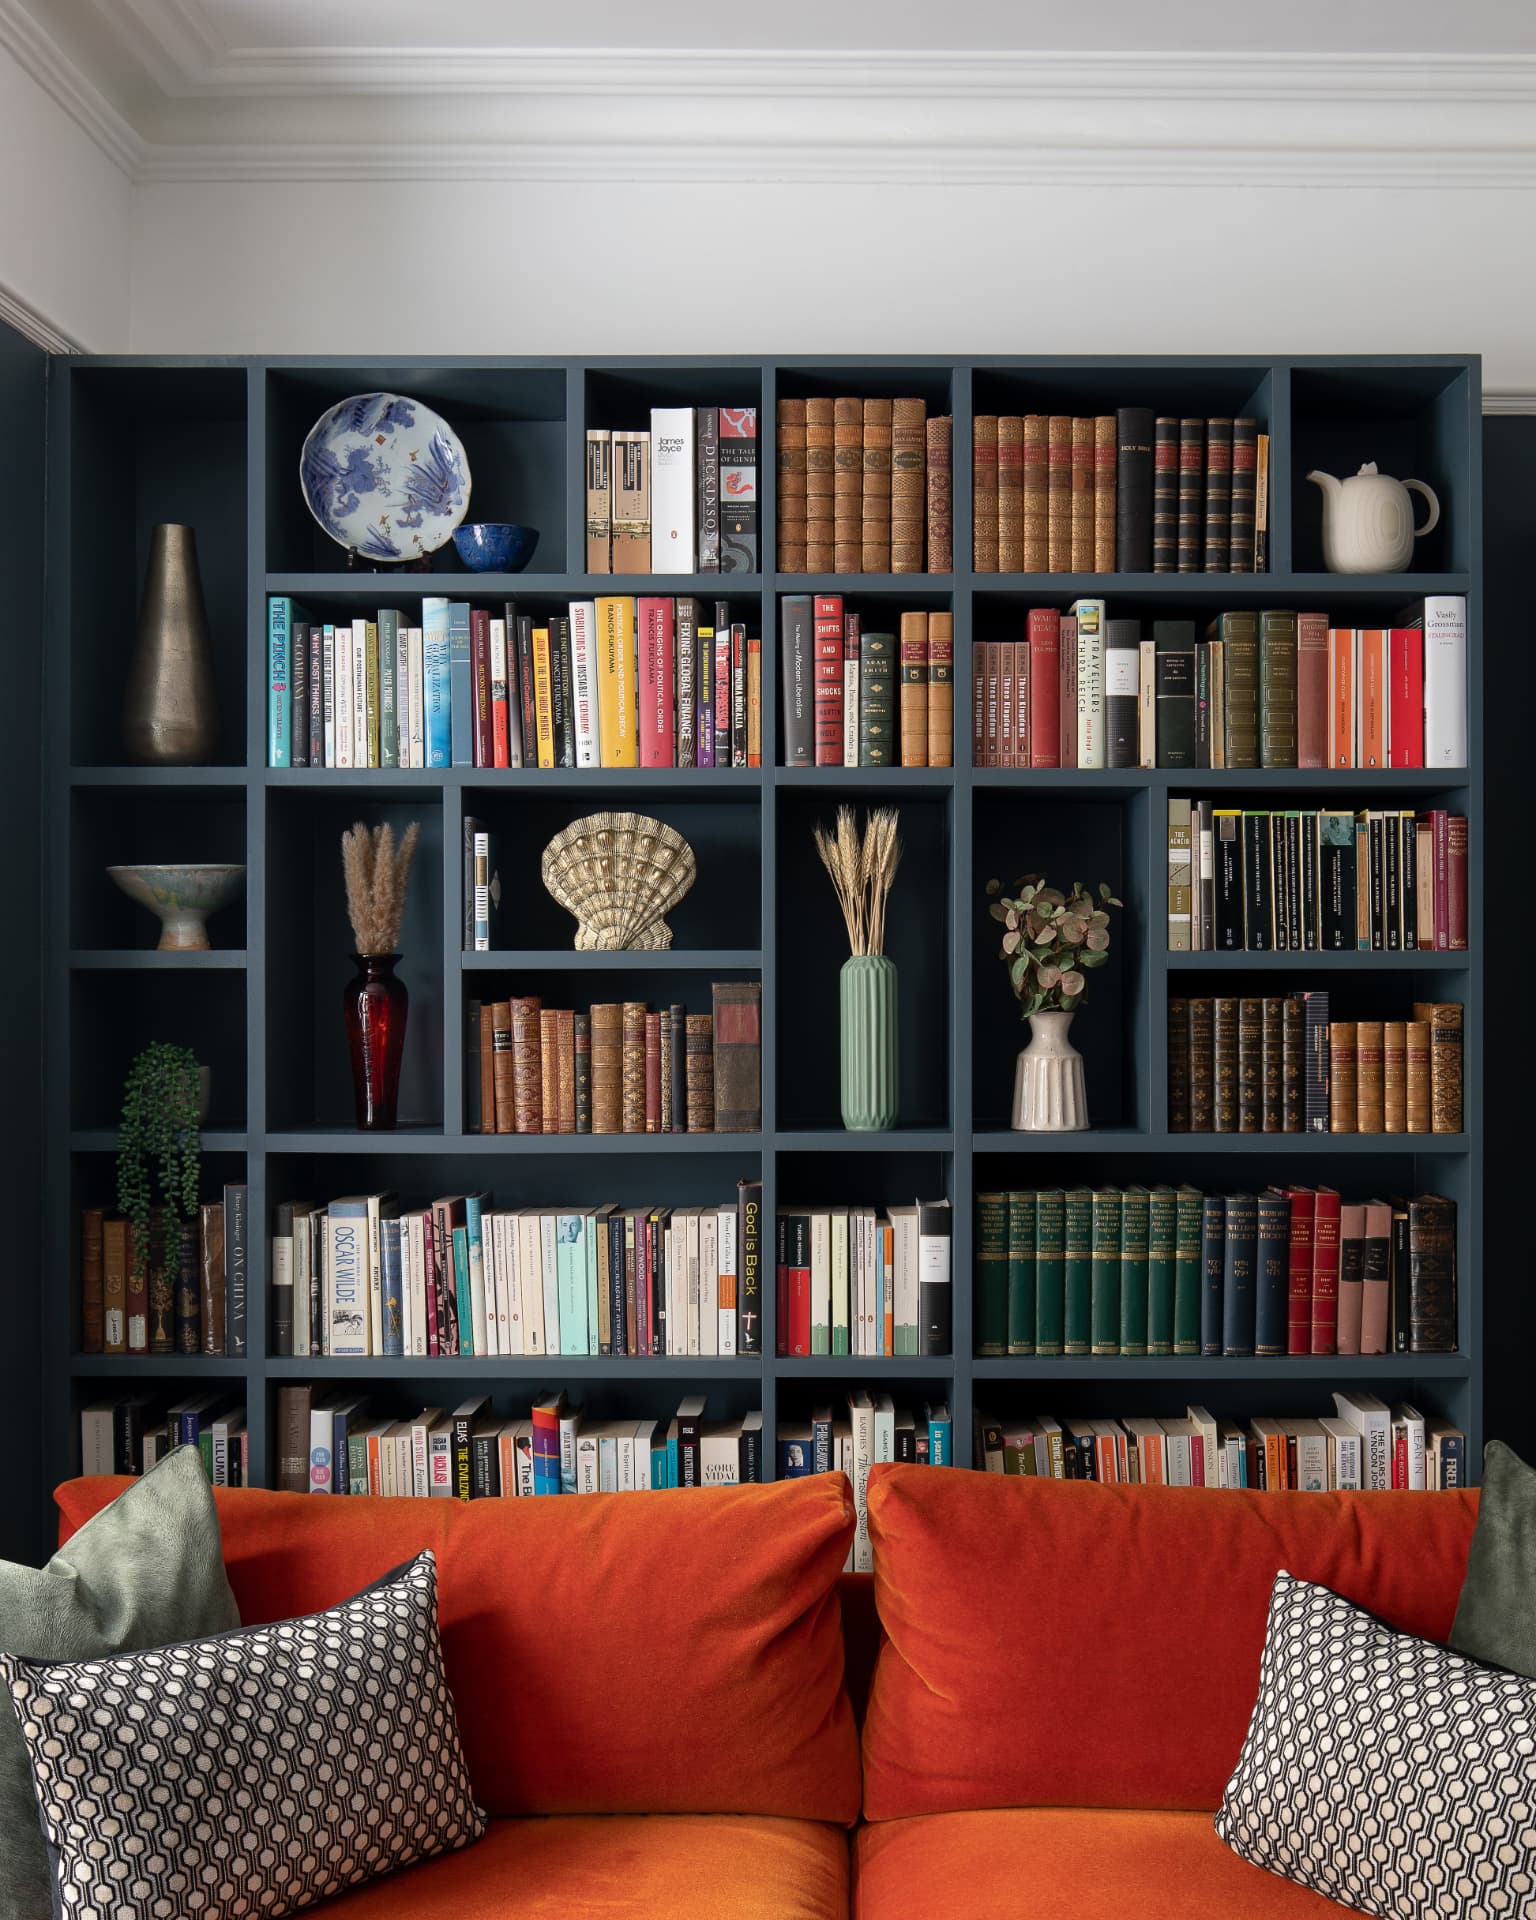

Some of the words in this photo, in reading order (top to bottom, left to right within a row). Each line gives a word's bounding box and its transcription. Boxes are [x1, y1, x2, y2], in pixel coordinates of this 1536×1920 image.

[705, 446, 715, 543] DICKINSON
[273, 601, 285, 630] THE
[574, 608, 585, 650] STABILIZING
[1427, 620, 1464, 628] Grossman
[1436, 611, 1456, 620] Vasily
[656, 625, 664, 656] ORIGINS
[680, 622, 690, 654] FIXING
[273, 634, 285, 680] PINCH
[295, 644, 303, 700] COMPANY
[425, 644, 433, 674] WORKS
[561, 655, 568, 664] OF
[576, 653, 586, 663] AN
[657, 658, 664, 668] OF
[432, 643, 440, 713] GLOBALIZATION
[577, 664, 587, 697] UNSTABLE
[681, 657, 690, 695] GLOBAL
[735, 668, 743, 695] MINIMA
[1091, 640, 1100, 713] TRAVELLERS
[554, 684, 562, 724] FUKUYAMA
[579, 700, 589, 734] ECONOMY
[681, 698, 691, 739] FINANCE
[735, 696, 743, 729] MORALIA
[975, 701, 983, 737] Kingdoms
[1018, 701, 1026, 737] Kingdoms
[746, 1202, 757, 1234] God
[233, 1247, 244, 1267] ON
[335, 1226, 355, 1266] OSCAR
[746, 1238, 757, 1251] is
[335, 1269, 355, 1304] WILDE
[746, 1255, 757, 1296] Back
[233, 1272, 244, 1320] CHINA
[457, 1422, 467, 1442] ELIAS
[563, 1432, 571, 1448] ADAM
[1052, 1436, 1062, 1459] Ethnic
[1413, 1428, 1423, 1459] LEAN
[416, 1447, 424, 1466] STOLE
[434, 1456, 447, 1483] BACKLASH
[458, 1447, 469, 1462] THE
[684, 1446, 694, 1480] STRUCTURES
[706, 1464, 735, 1472] GORE
[1415, 1463, 1423, 1474] IN
[458, 1463, 469, 1502] CIVILIZING
[522, 1464, 531, 1483] The
[705, 1472, 737, 1480] VIDAL
